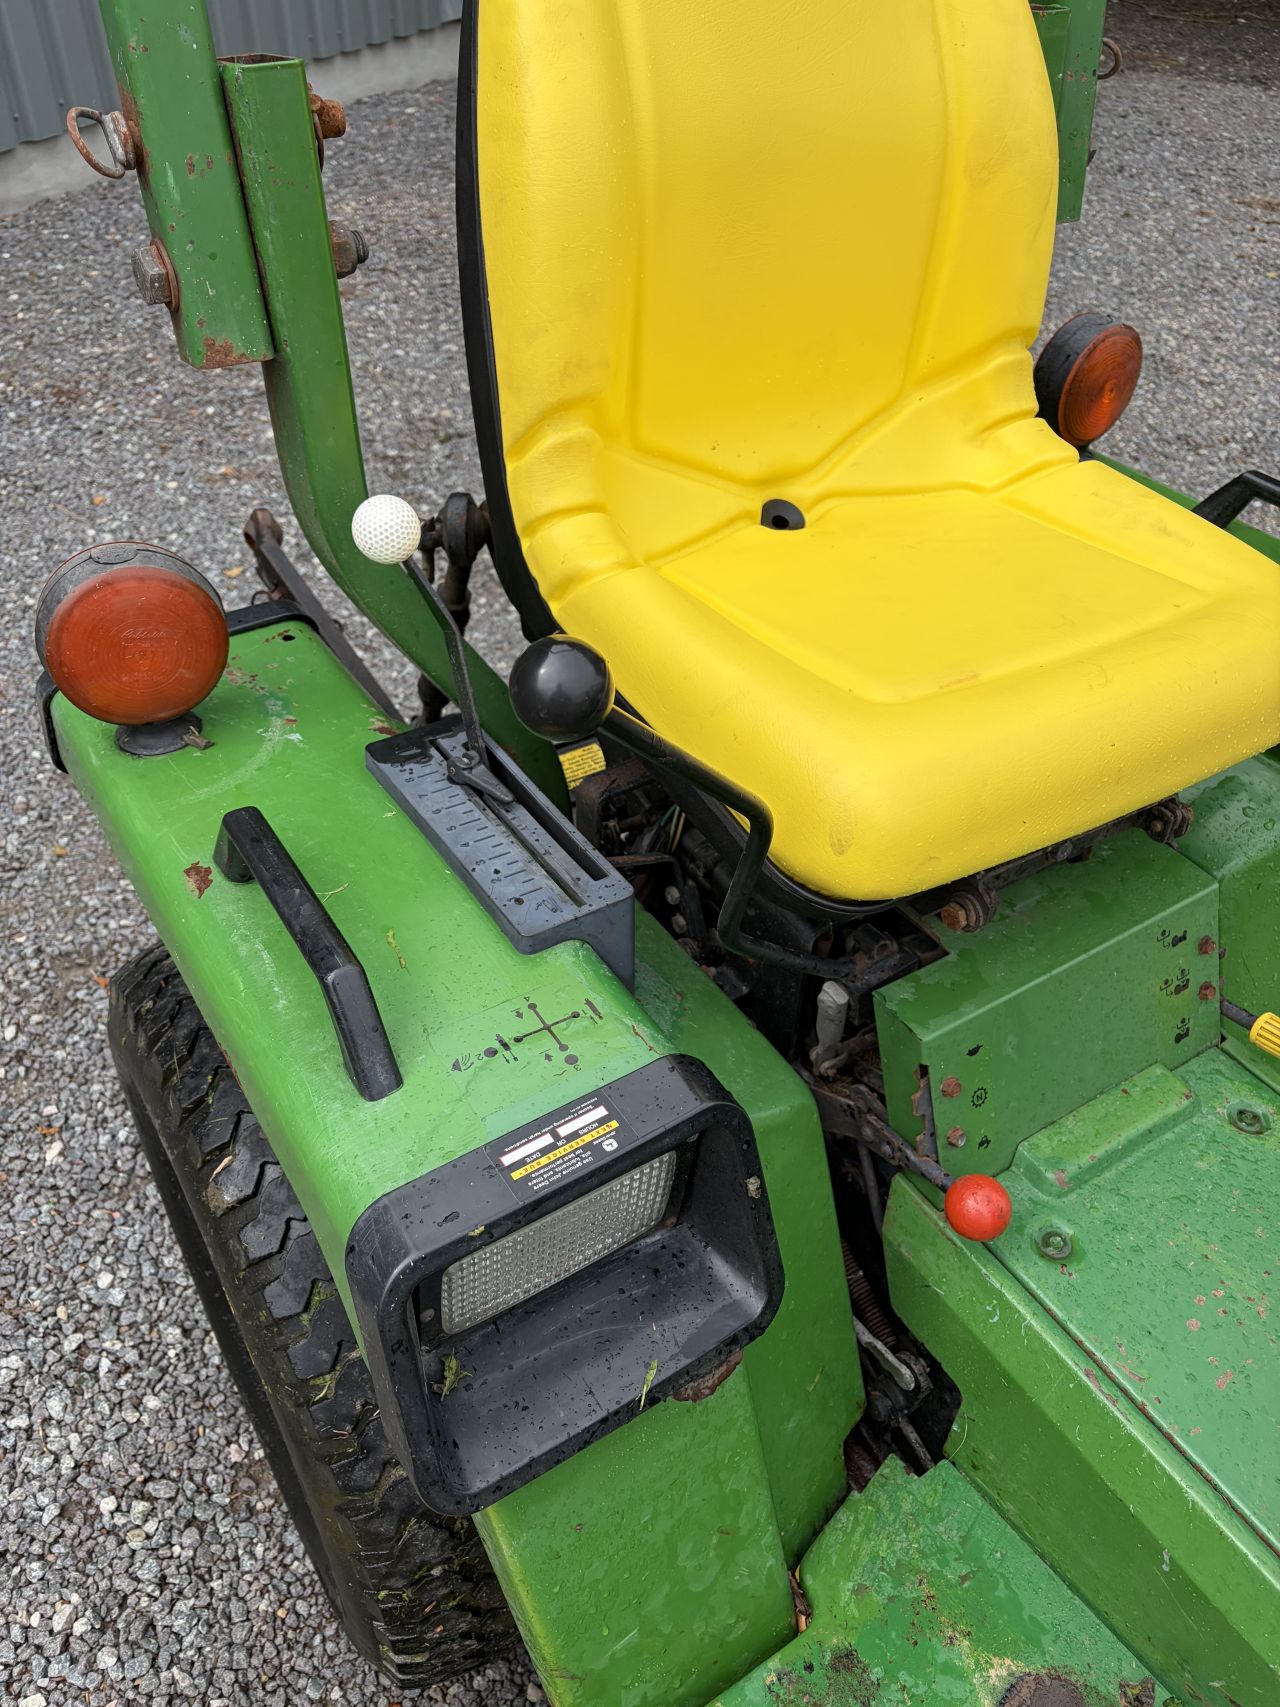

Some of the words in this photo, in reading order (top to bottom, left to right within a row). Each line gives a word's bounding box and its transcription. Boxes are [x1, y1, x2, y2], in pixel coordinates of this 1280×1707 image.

[578, 1122, 599, 1135] HOURS
[589, 1124, 613, 1138] NEXT
[545, 1138, 586, 1161] SERVICE
[574, 1148, 583, 1156] for
[524, 1152, 542, 1163] DATE
[563, 1153, 575, 1161] best
[582, 1156, 594, 1165] Use
[561, 1161, 583, 1175] genuine
[543, 1171, 554, 1179] and
[548, 1173, 563, 1183] John
[528, 1176, 544, 1187] filters
[533, 1180, 550, 1191] Deere
